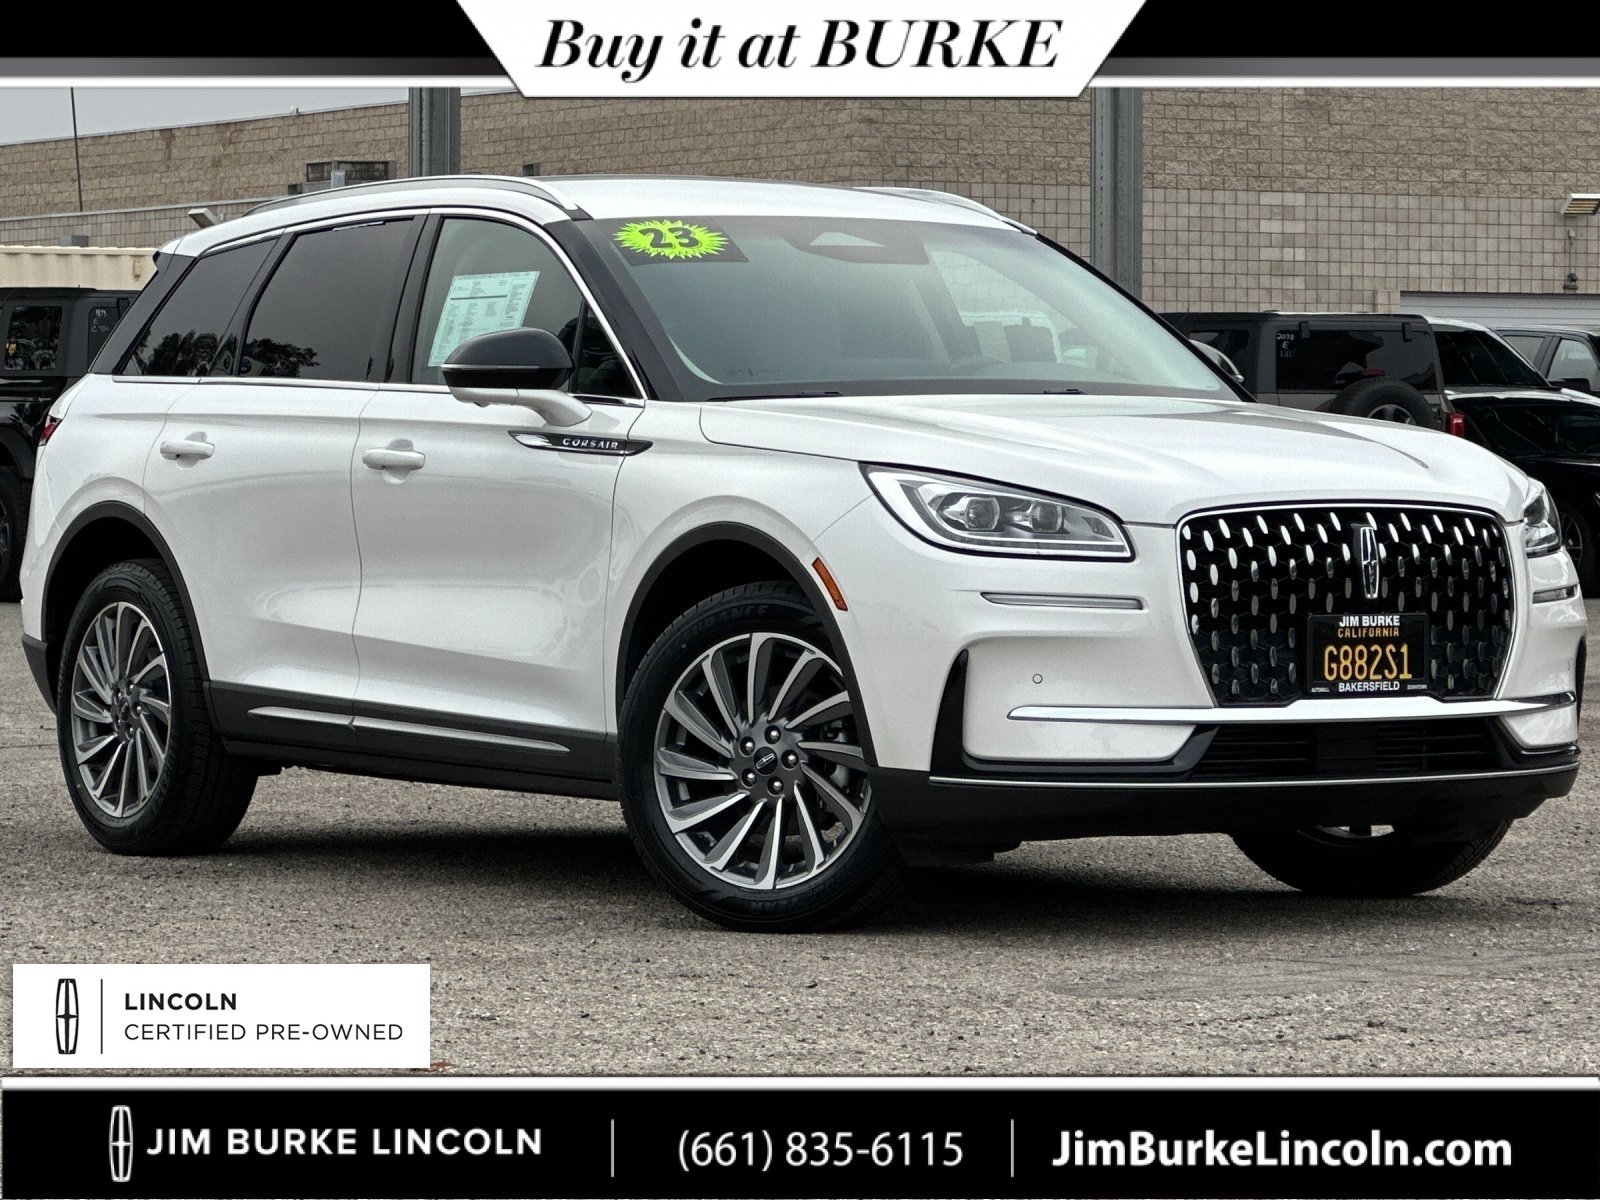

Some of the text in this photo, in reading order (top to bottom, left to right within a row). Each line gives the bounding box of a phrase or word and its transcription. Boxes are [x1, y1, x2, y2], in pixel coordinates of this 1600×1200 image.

[639, 227, 701, 249] 23
[562, 438, 619, 450] CORSAIR
[1338, 615, 1400, 627] JIM BURKE
[1337, 627, 1400, 638] CALIFORNIA
[1323, 643, 1413, 681] G882S1
[1338, 681, 1400, 693] BAKERSFIELD
